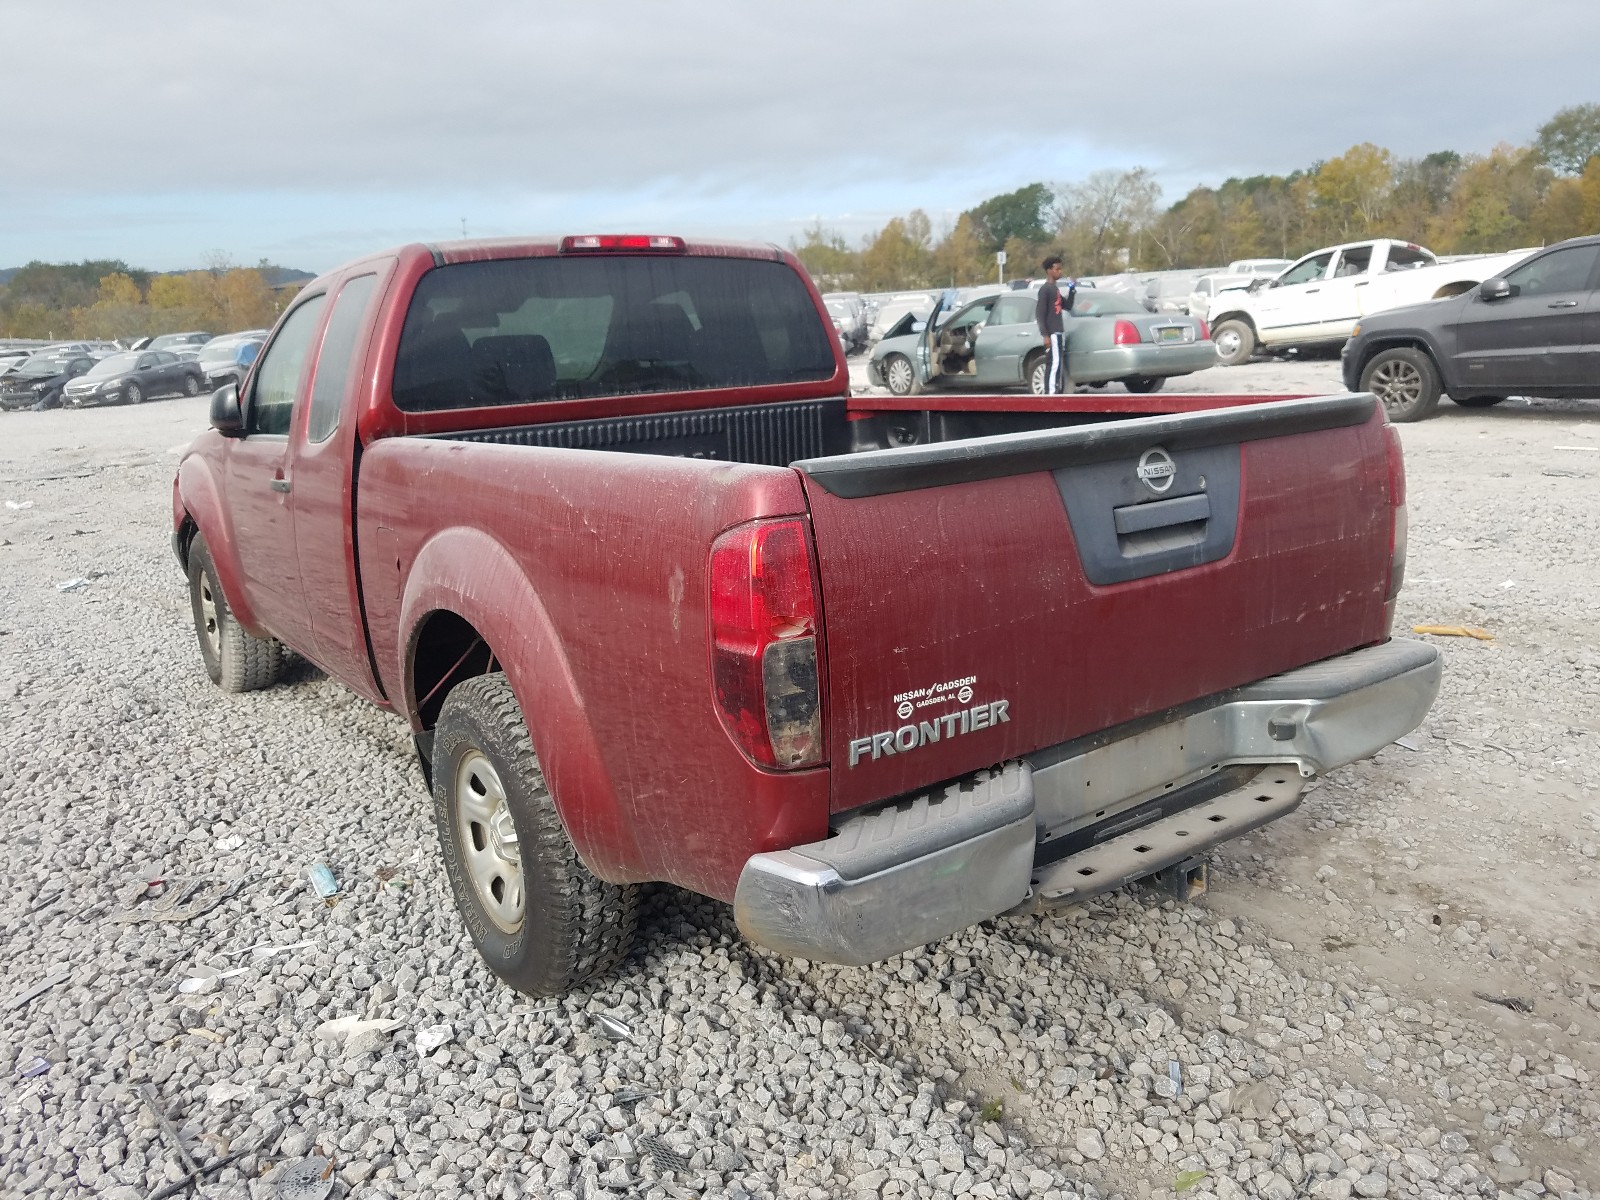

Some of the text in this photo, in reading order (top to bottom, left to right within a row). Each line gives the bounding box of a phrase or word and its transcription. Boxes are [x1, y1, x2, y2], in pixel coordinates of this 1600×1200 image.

[1143, 465, 1174, 476] NISSAN
[893, 675, 977, 703] NISSAN of GADSDEN
[916, 695, 947, 708] GADSDEN,
[850, 699, 1011, 767] FRONTIER
[437, 784, 488, 943] WRANGLER
